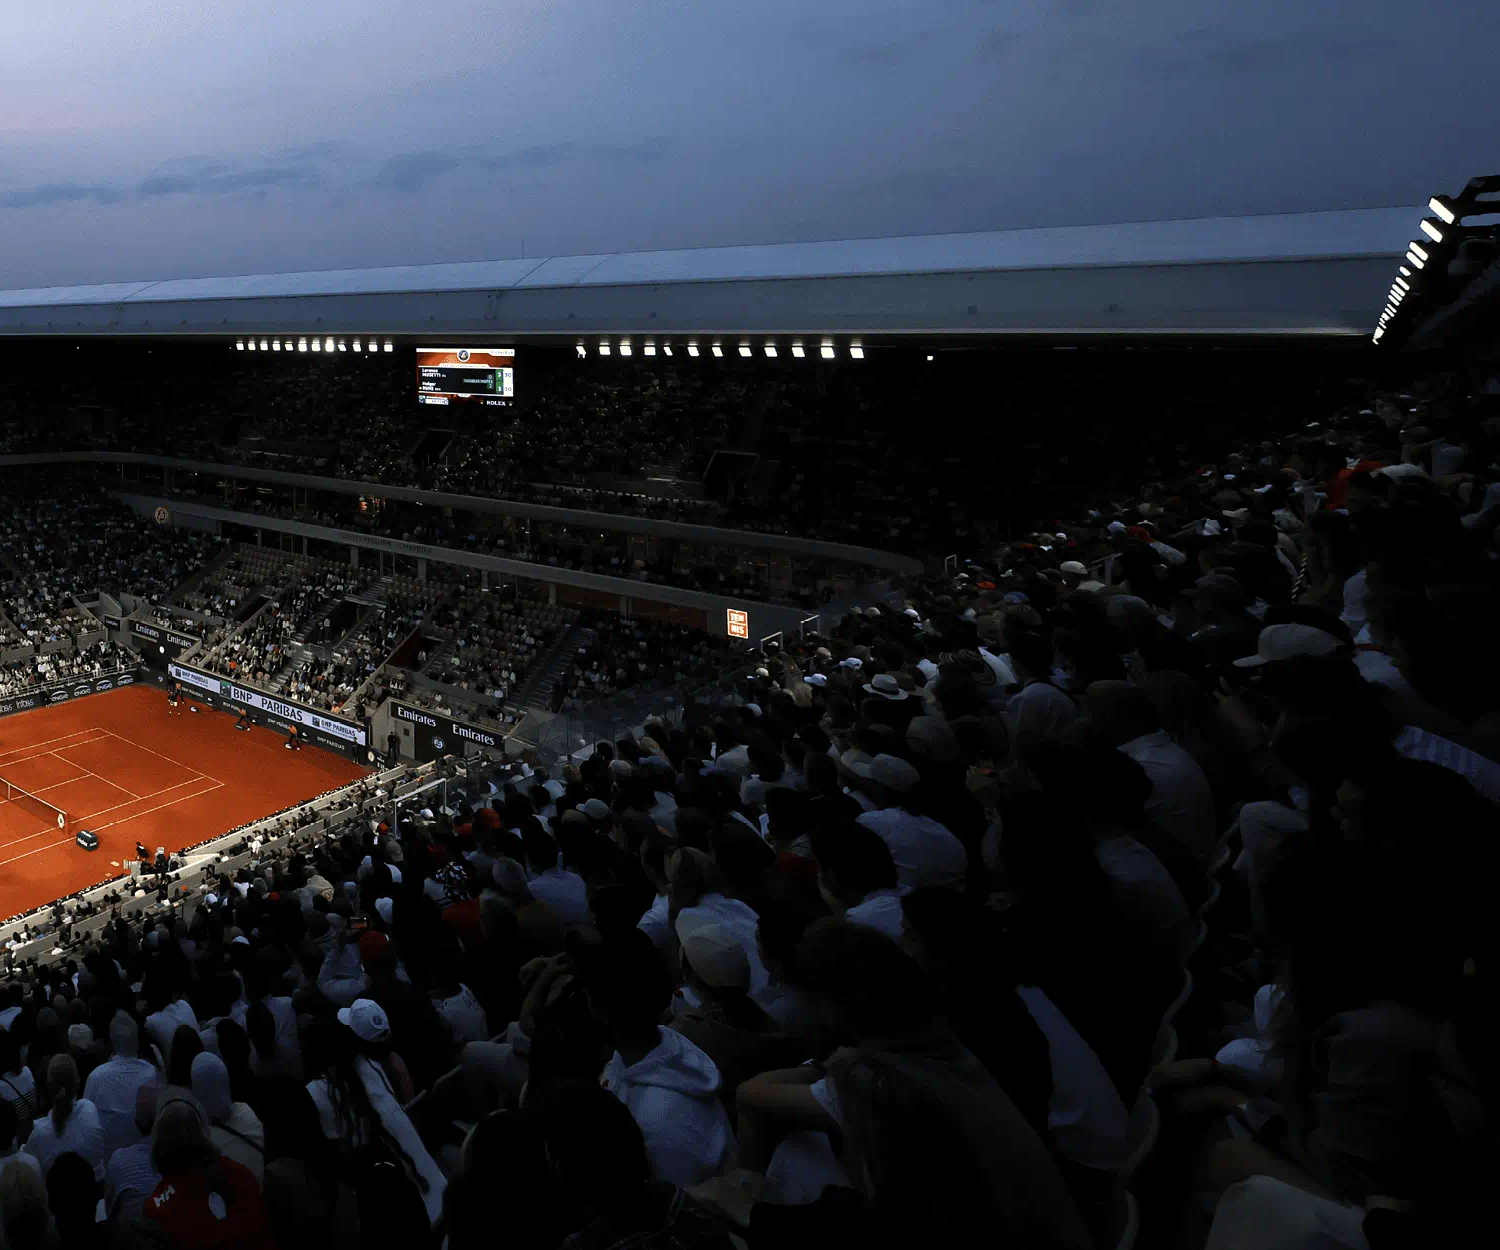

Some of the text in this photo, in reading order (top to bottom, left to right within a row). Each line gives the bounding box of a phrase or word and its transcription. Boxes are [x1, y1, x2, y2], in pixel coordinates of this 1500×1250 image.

[135, 623, 192, 647] Emirates Emirates
[233, 688, 303, 722] BNP PARIBAS
[321, 718, 333, 728] BNP
[332, 722, 356, 737] PARIBAS
[397, 706, 495, 746] Emirates Emirates
[327, 738, 345, 750] PARIBAS
